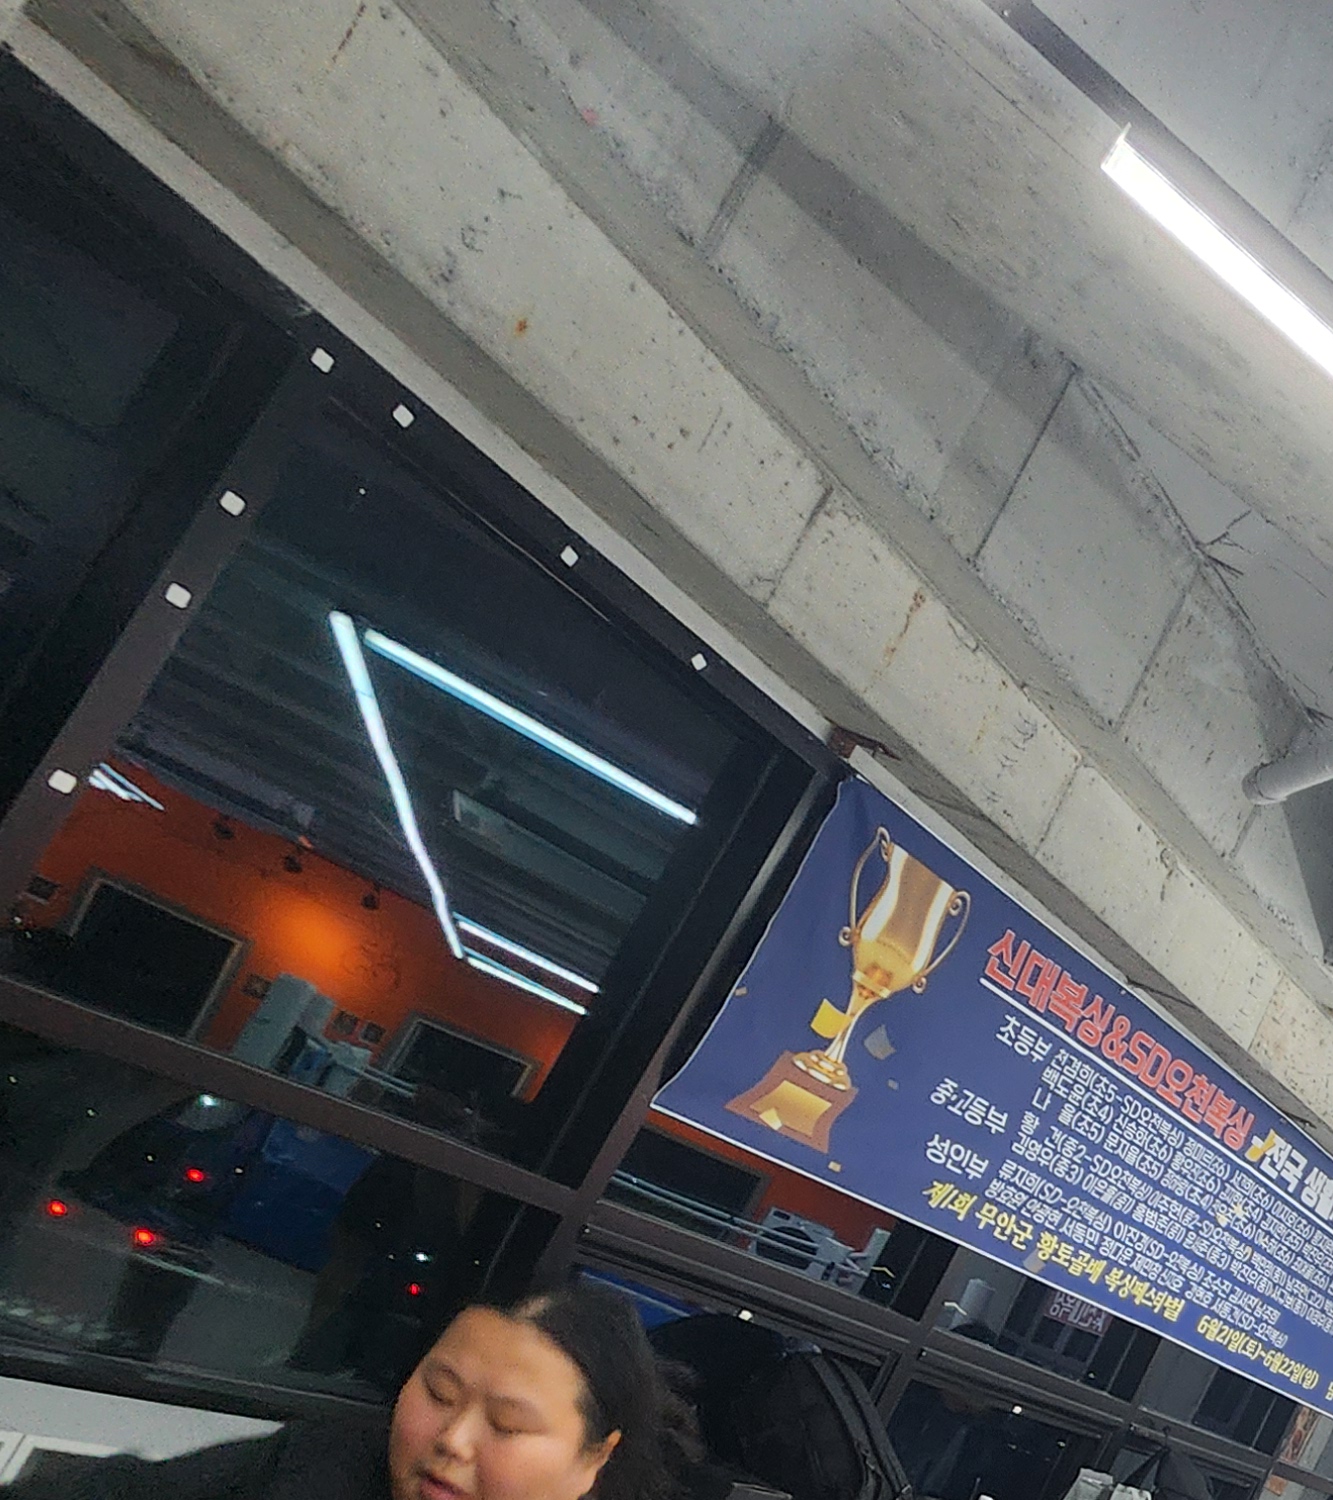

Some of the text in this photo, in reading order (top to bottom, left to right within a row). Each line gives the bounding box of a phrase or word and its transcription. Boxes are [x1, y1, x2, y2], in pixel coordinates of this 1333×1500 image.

[982, 927, 1256, 1152] 신대복싱&SD오천복싱
[1257, 1134, 1310, 1192] 전국
[994, 1013, 1052, 1064] 초등부
[1018, 1110, 1041, 1136] 황
[1030, 1086, 1054, 1112] 나
[923, 1132, 990, 1182] 성인부
[920, 1178, 978, 1222] 제1회
[972, 1200, 1036, 1250] 무안군
[1030, 1230, 1108, 1284] 황토골배
[1102, 1266, 1186, 1322] 복싱페스티벌
[1058, 1216, 1102, 1250] 서동민
